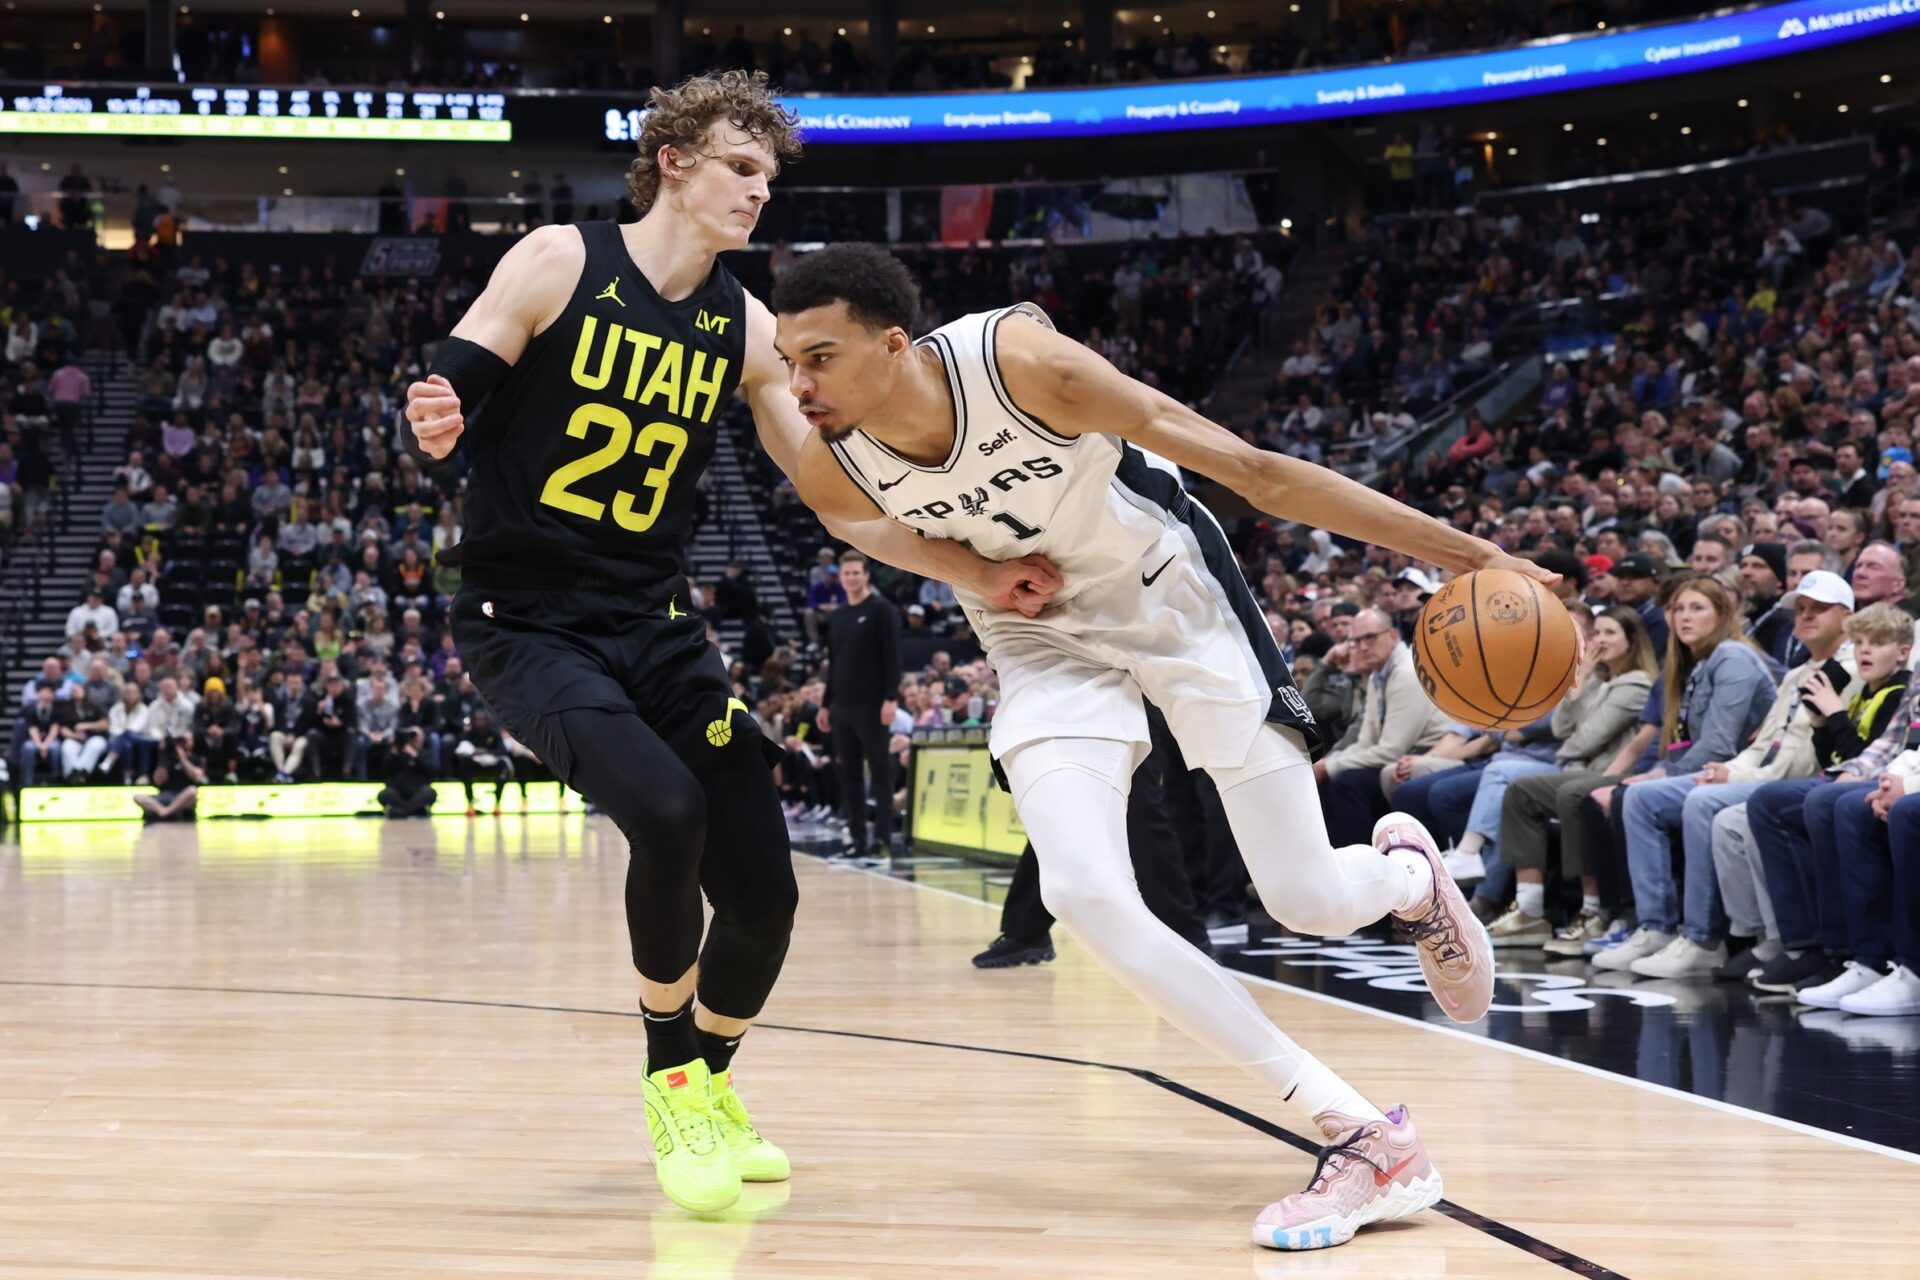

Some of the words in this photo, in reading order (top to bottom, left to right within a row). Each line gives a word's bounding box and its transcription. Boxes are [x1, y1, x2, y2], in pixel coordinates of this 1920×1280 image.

[1808, 4, 1887, 33] MORETON
[1888, 0, 1903, 16] &
[1645, 47, 1681, 64] Cyber
[1683, 36, 1741, 57] Insurance
[1483, 66, 1533, 87] Personal
[1534, 63, 1567, 80] Lines
[1317, 89, 1354, 105] Surety
[1356, 86, 1366, 100] &
[1367, 81, 1406, 100] Bonds
[824, 114, 838, 129] &
[838, 114, 911, 129] COMPANY
[943, 112, 1001, 128] Employee
[1002, 109, 1051, 125] Benefits
[1126, 104, 1177, 120] Property
[1179, 101, 1189, 115] &
[1189, 98, 1241, 115] Casualty
[695, 309, 731, 335] LVT
[571, 314, 729, 424] UTAH
[978, 428, 1018, 456] Self.
[539, 403, 689, 532] 23
[989, 511, 1045, 541] 1
